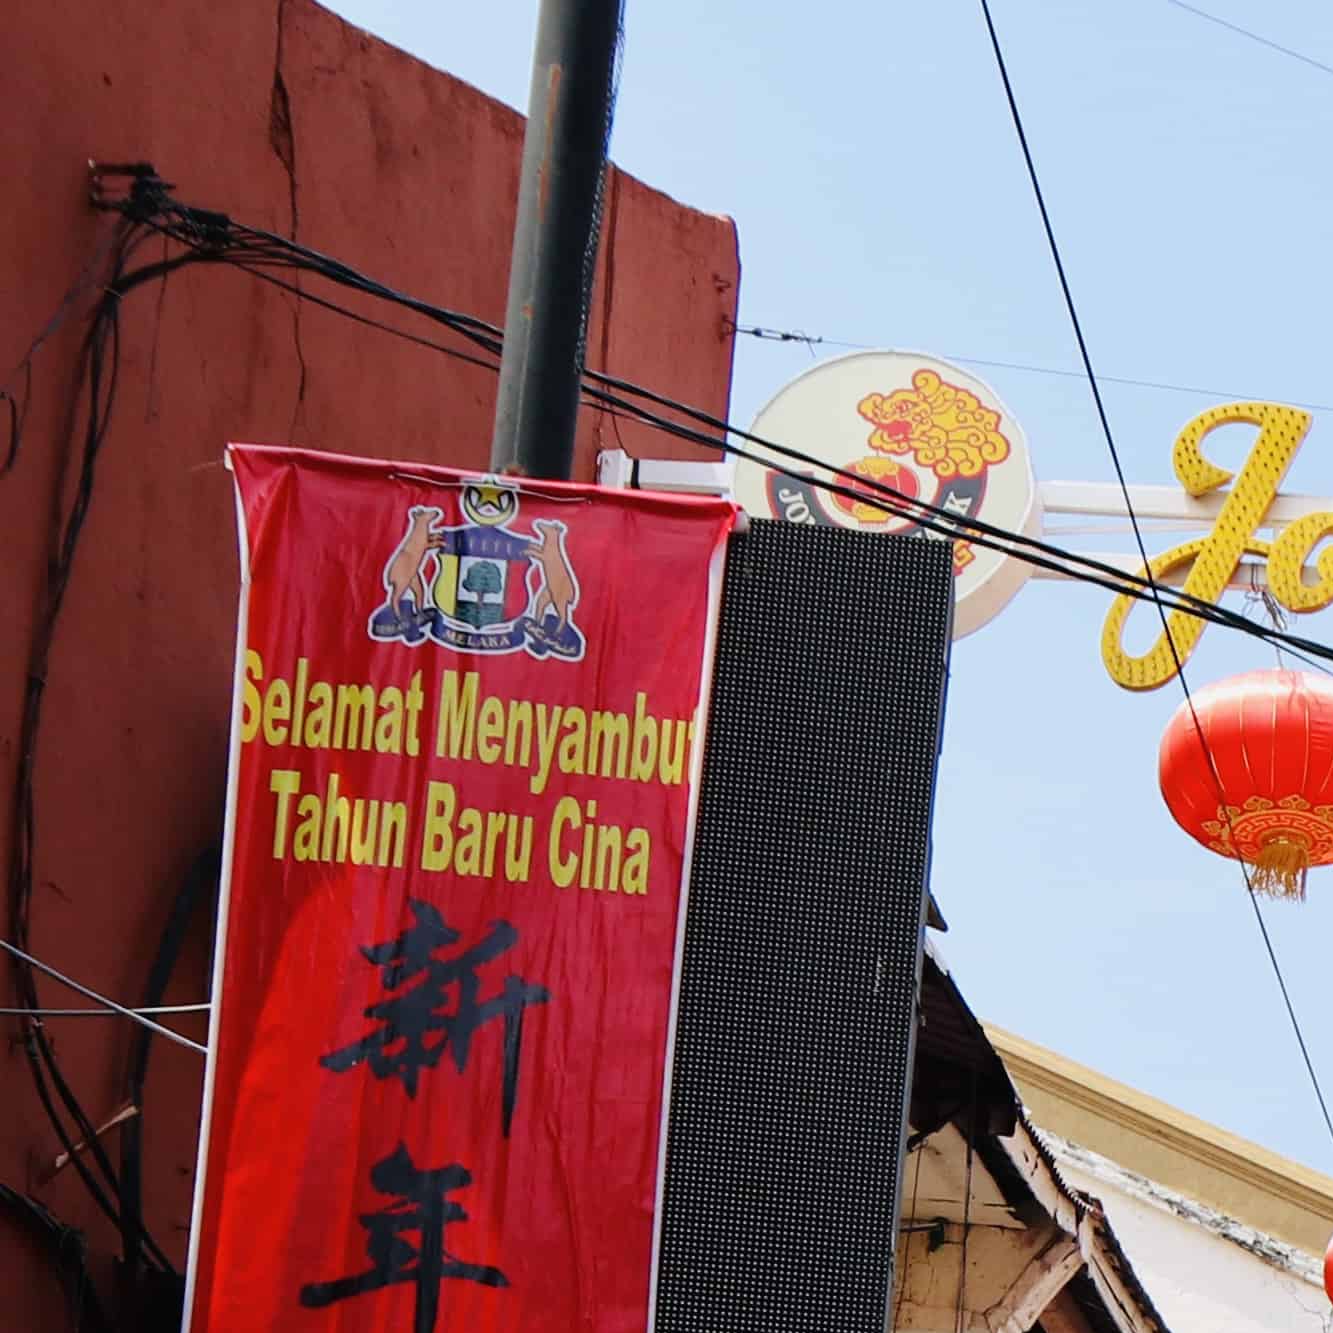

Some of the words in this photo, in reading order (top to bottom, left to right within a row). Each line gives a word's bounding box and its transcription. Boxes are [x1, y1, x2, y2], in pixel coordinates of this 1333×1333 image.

[445, 630, 512, 647] MELAKA
[241, 648, 424, 757] Selamat
[269, 768, 408, 868] Tahun
[421, 780, 533, 882] Baru
[548, 795, 652, 895] Cina
